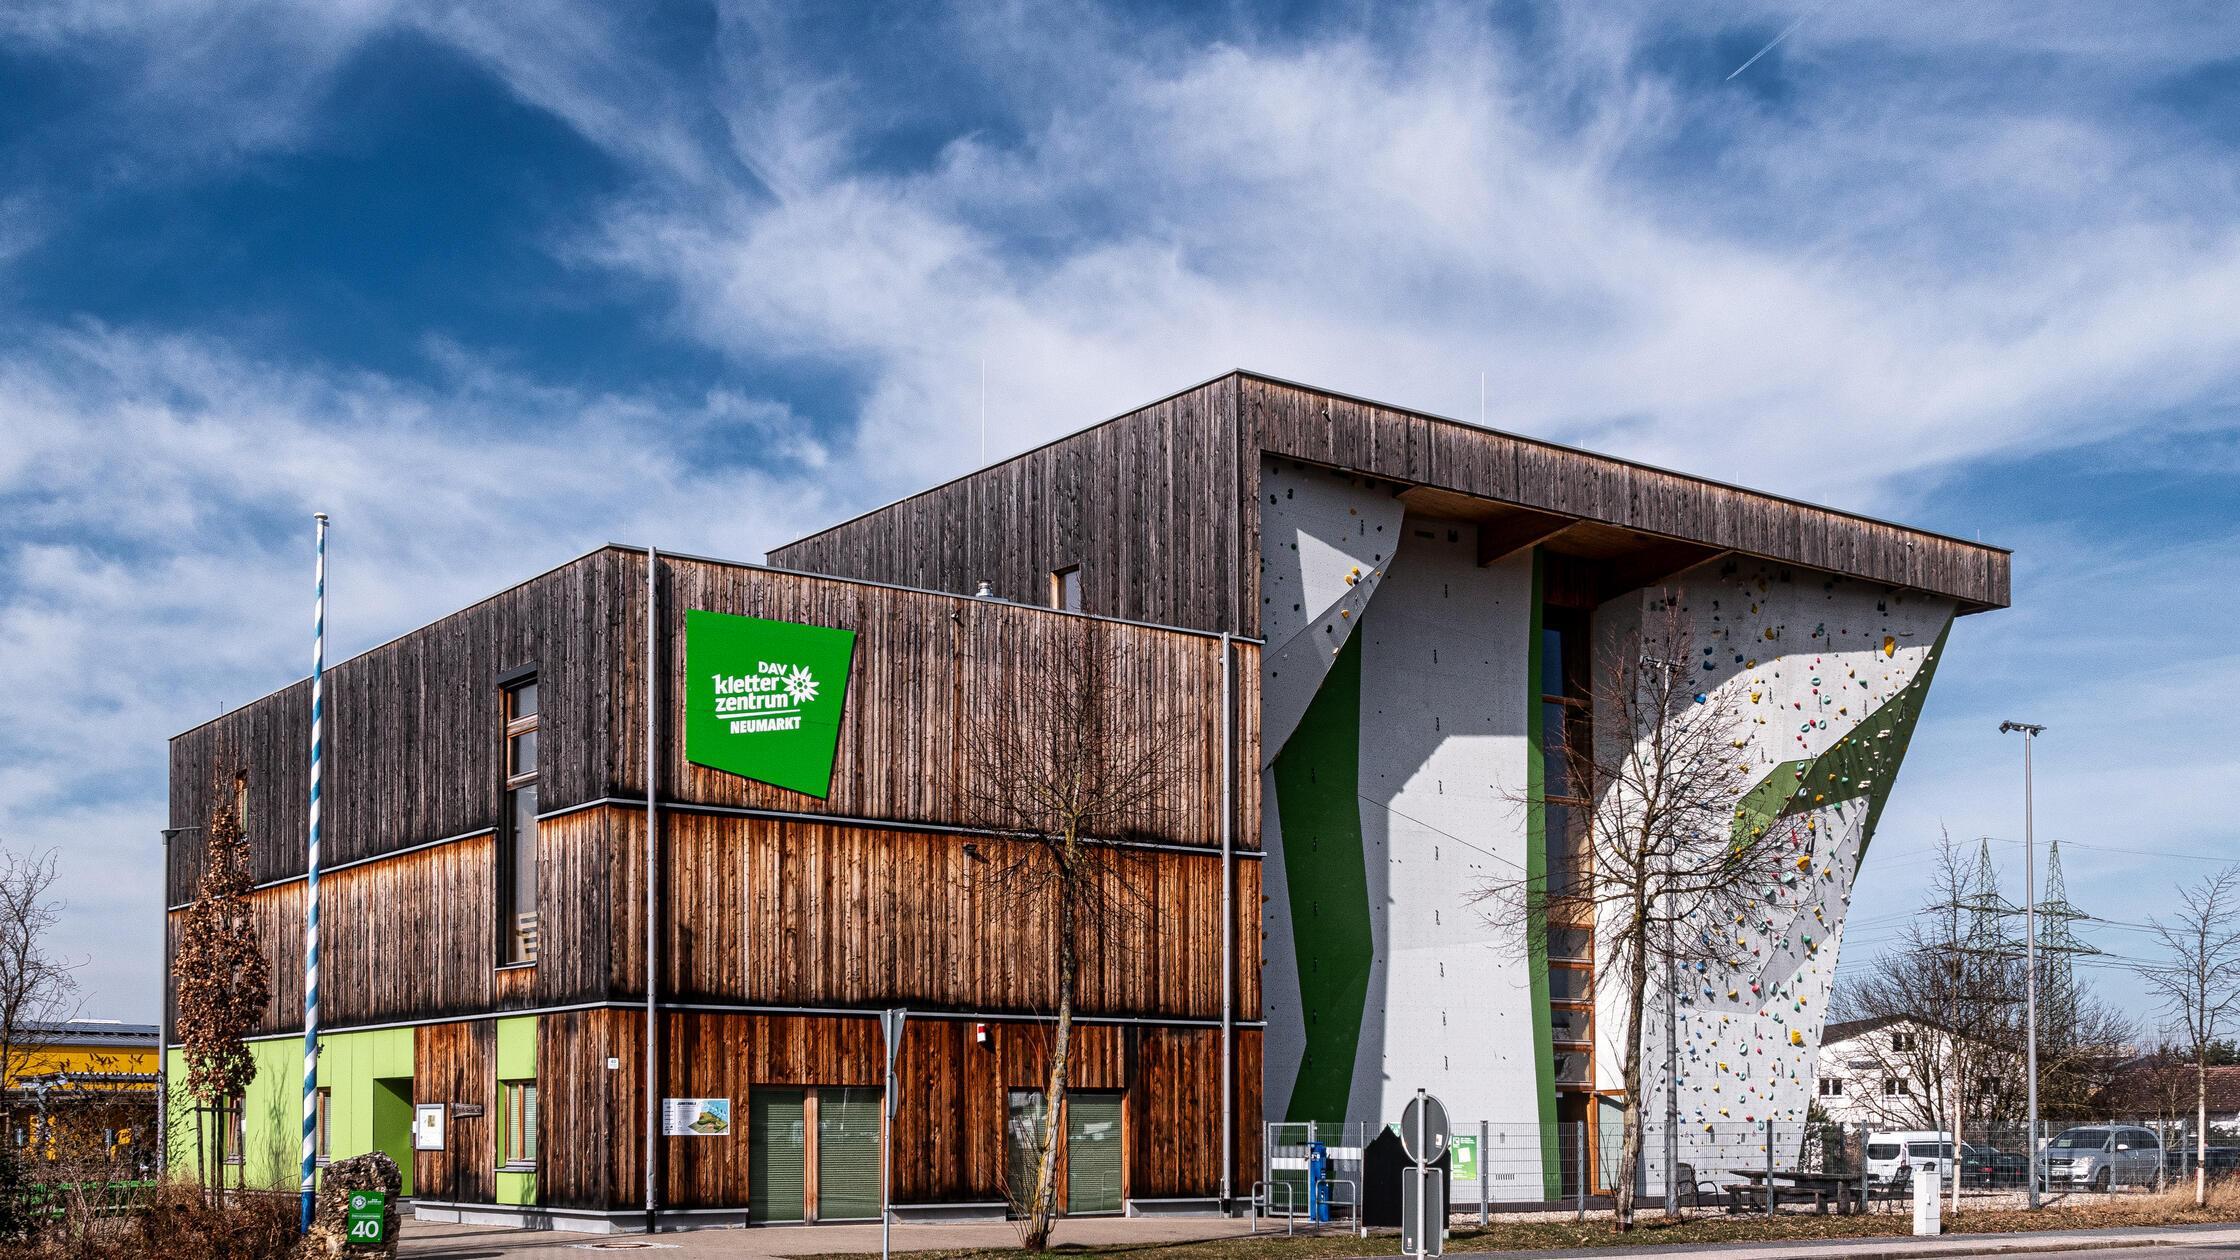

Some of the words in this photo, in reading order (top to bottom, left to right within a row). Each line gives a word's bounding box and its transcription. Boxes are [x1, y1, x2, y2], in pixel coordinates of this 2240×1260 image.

[758, 661, 787, 675] DAV
[711, 673, 780, 694] kletter
[715, 692, 788, 712] zentrum
[730, 716, 801, 734] NEUMARKT
[351, 1220, 379, 1238] 40
